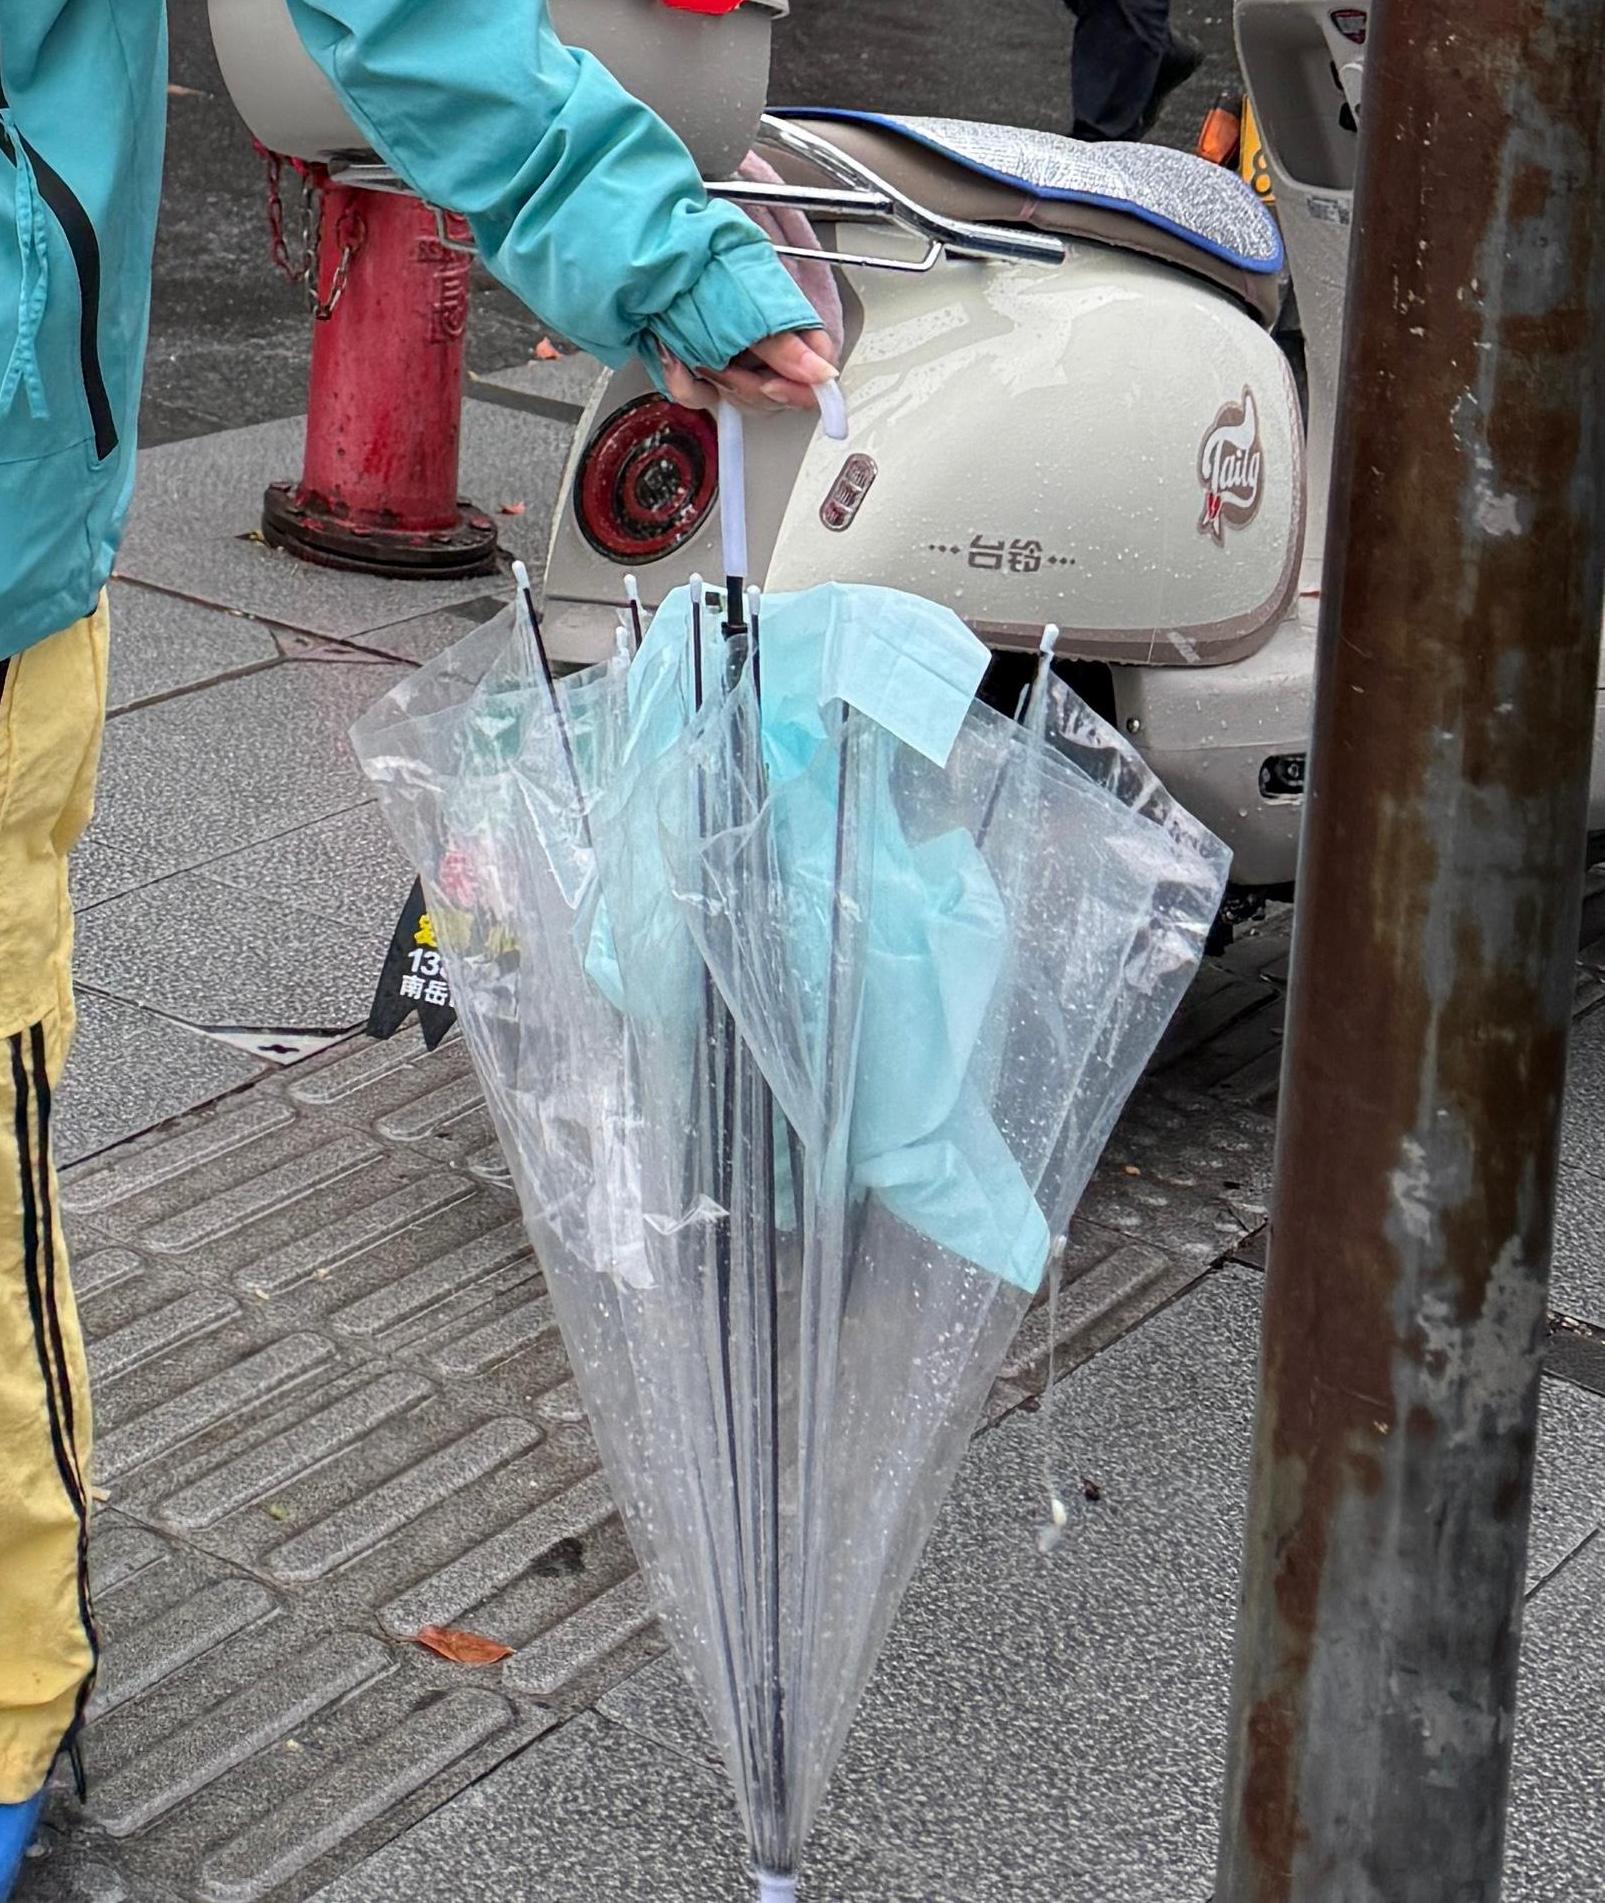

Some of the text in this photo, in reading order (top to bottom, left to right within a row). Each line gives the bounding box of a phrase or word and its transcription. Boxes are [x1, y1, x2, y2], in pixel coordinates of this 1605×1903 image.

[968, 534, 1043, 572] 台铃
[407, 948, 449, 982] 13
[400, 974, 454, 1007] 南岳
